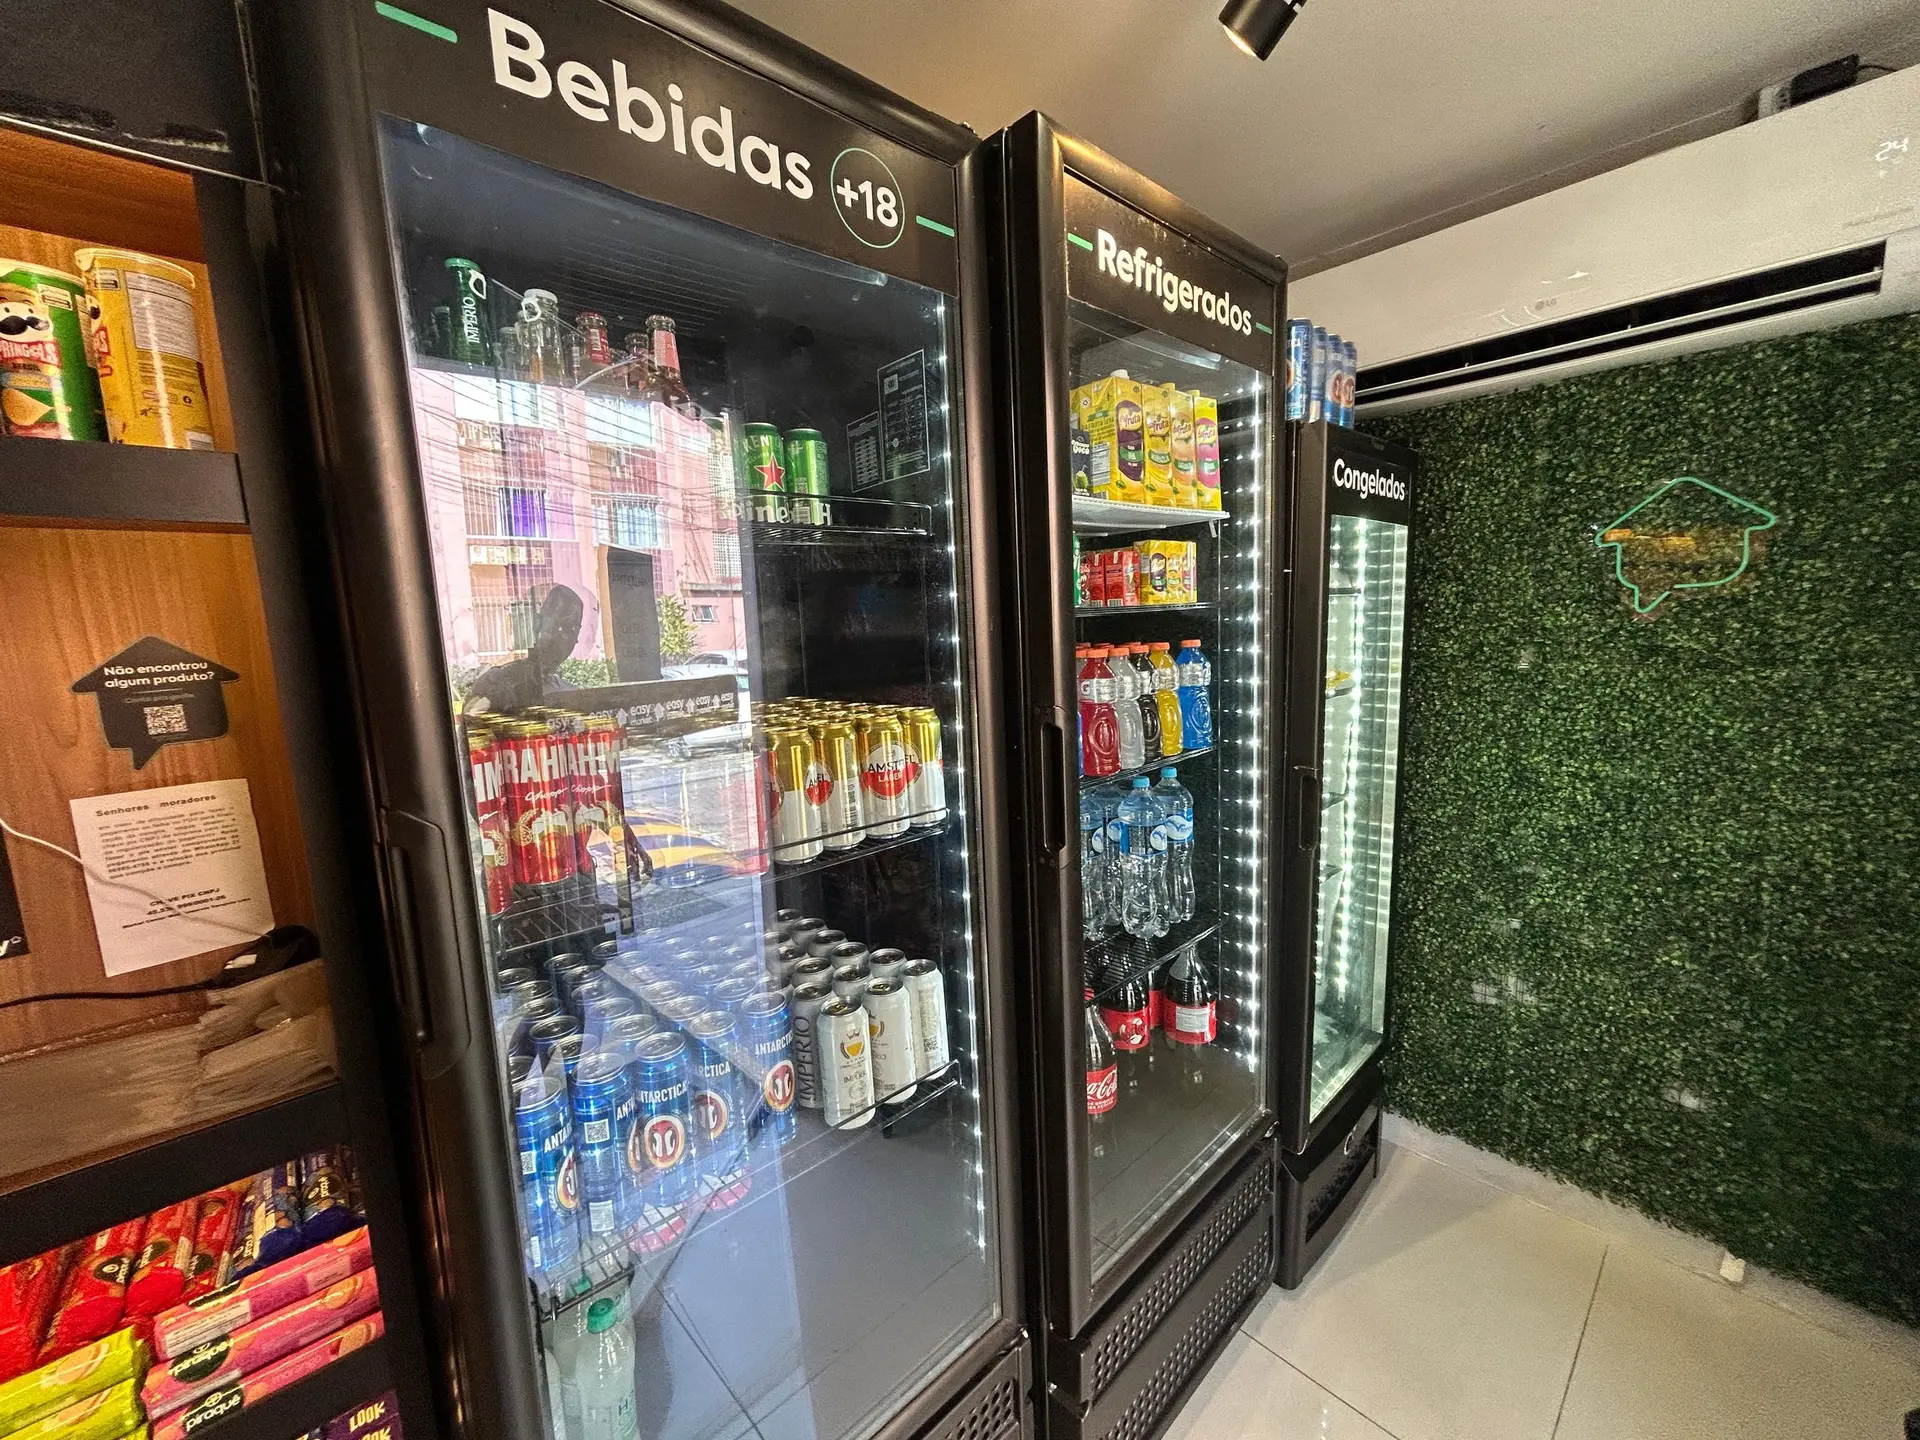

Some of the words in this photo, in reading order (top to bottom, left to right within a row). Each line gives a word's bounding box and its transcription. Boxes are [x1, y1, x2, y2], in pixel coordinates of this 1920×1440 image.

[487, 7, 814, 200] Bebidas
[1876, 137, 1909, 161] 24
[836, 177, 899, 228] +18
[1098, 228, 1252, 336] Refrigerados
[1333, 458, 1405, 502] Congelados
[104, 665, 135, 676] Não
[137, 662, 208, 674] encontrou
[104, 676, 151, 689] algum
[153, 671, 215, 685] produto?
[630, 703, 652, 717] easy
[96, 804, 149, 817] Senhores
[160, 795, 216, 807] moradores
[185, 1393, 242, 1433] piraquê
[349, 1401, 386, 1433] LOOK
